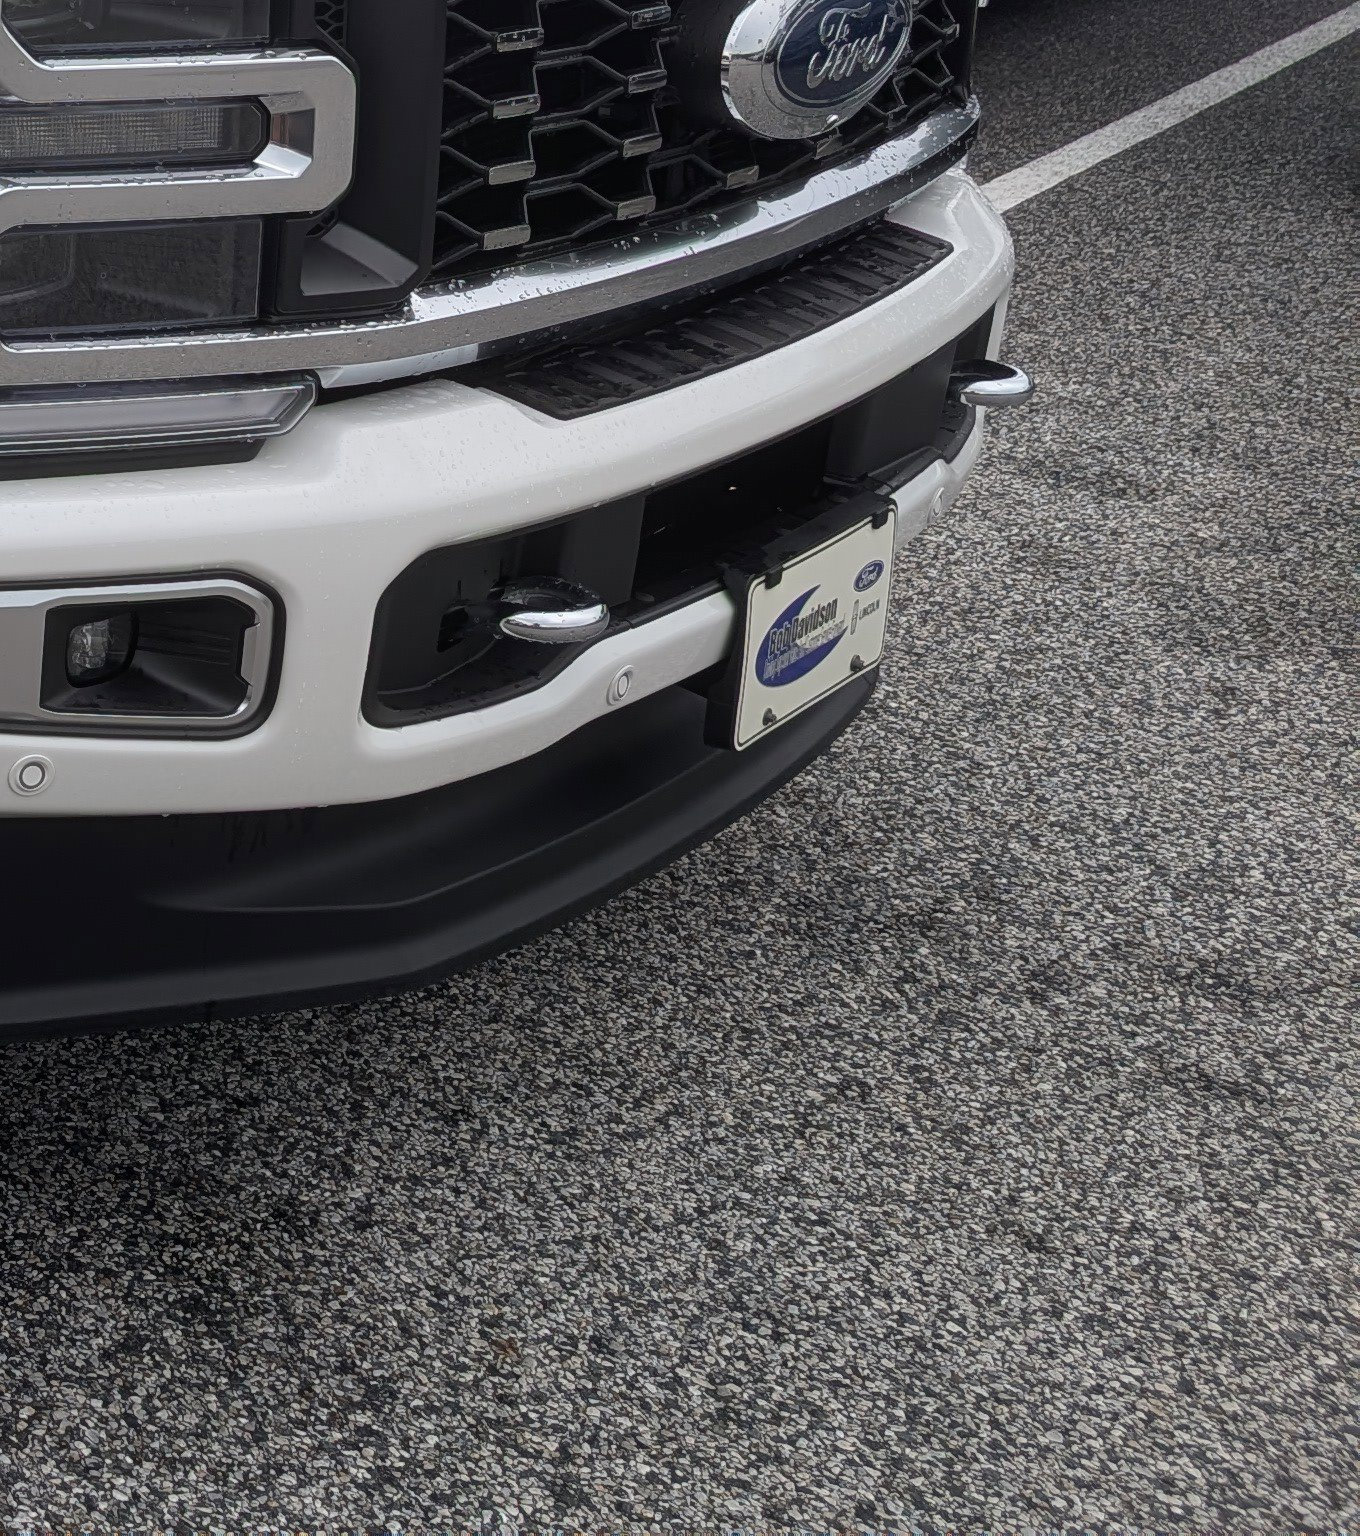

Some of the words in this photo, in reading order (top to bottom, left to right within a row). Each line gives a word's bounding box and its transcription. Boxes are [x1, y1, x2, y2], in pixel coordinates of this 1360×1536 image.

[805, 0, 890, 90] Ford
[768, 620, 793, 657] Bob
[791, 597, 839, 644] Davidson
